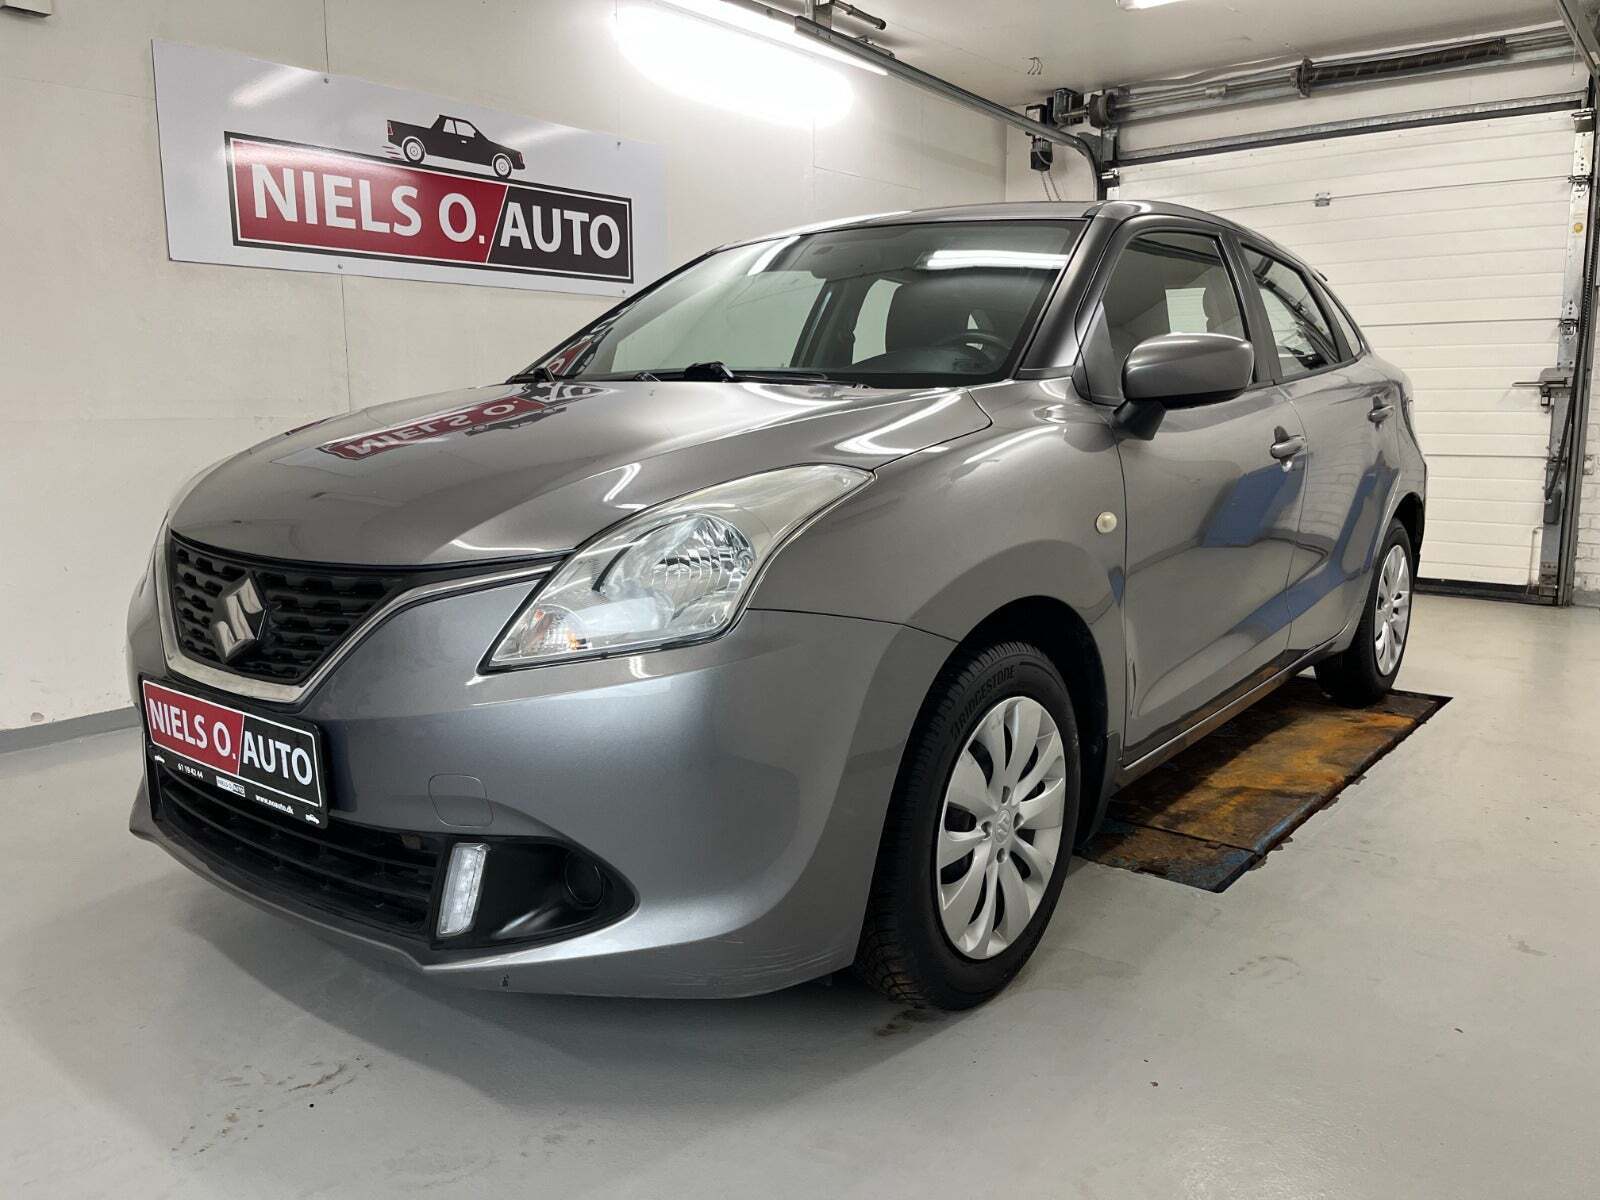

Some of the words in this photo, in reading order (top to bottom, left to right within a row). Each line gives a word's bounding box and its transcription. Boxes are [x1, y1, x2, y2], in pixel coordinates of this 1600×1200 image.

[252, 164, 421, 237] NIELS
[439, 193, 485, 244] O.
[500, 202, 620, 259] AUTO
[149, 698, 208, 749] NIELS
[213, 721, 236, 760] O.
[243, 731, 312, 785] AUTO
